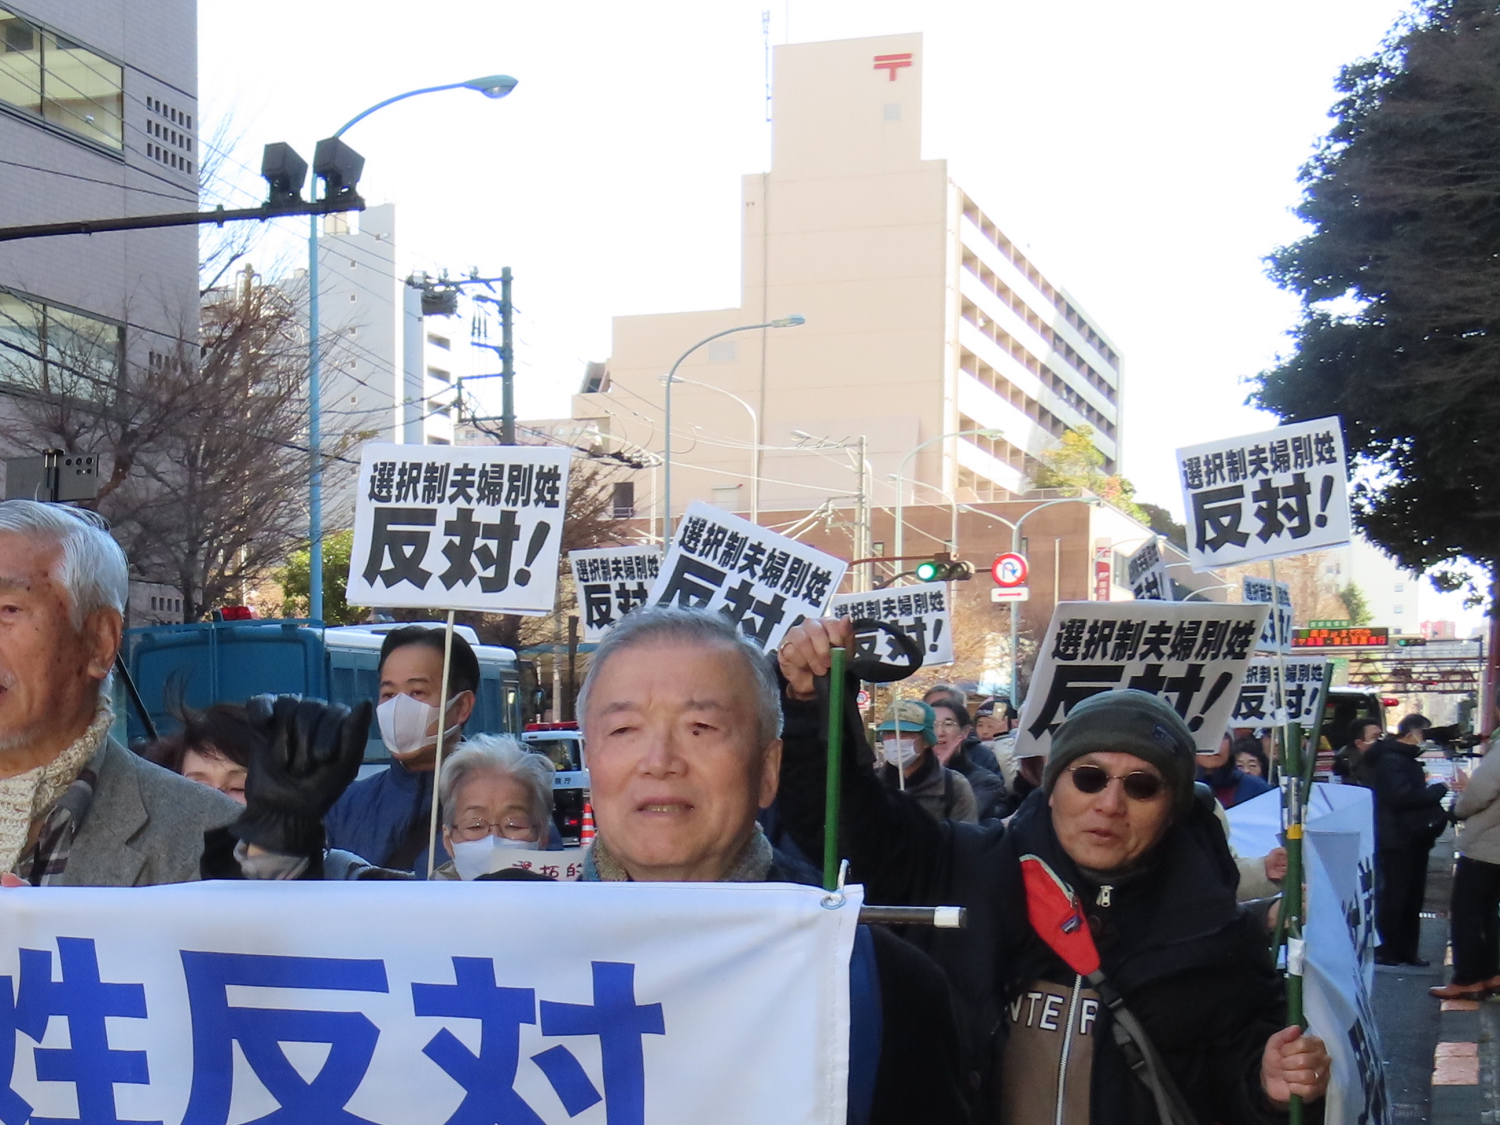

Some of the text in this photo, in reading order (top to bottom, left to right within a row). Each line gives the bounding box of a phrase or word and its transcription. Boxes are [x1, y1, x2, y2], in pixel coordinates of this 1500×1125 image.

[367, 461, 562, 509] 選択制夫婦別姓
[1182, 430, 1337, 490] 選択制夫婦別姓
[1191, 471, 1334, 554] 反対!
[362, 507, 551, 593] 反対!
[575, 554, 659, 582] 選択制夫婦別姓
[678, 514, 833, 609] 選択制夫婦別姓
[656, 553, 806, 648] 反対
[1051, 618, 1256, 662] 選択制夫婦別姓
